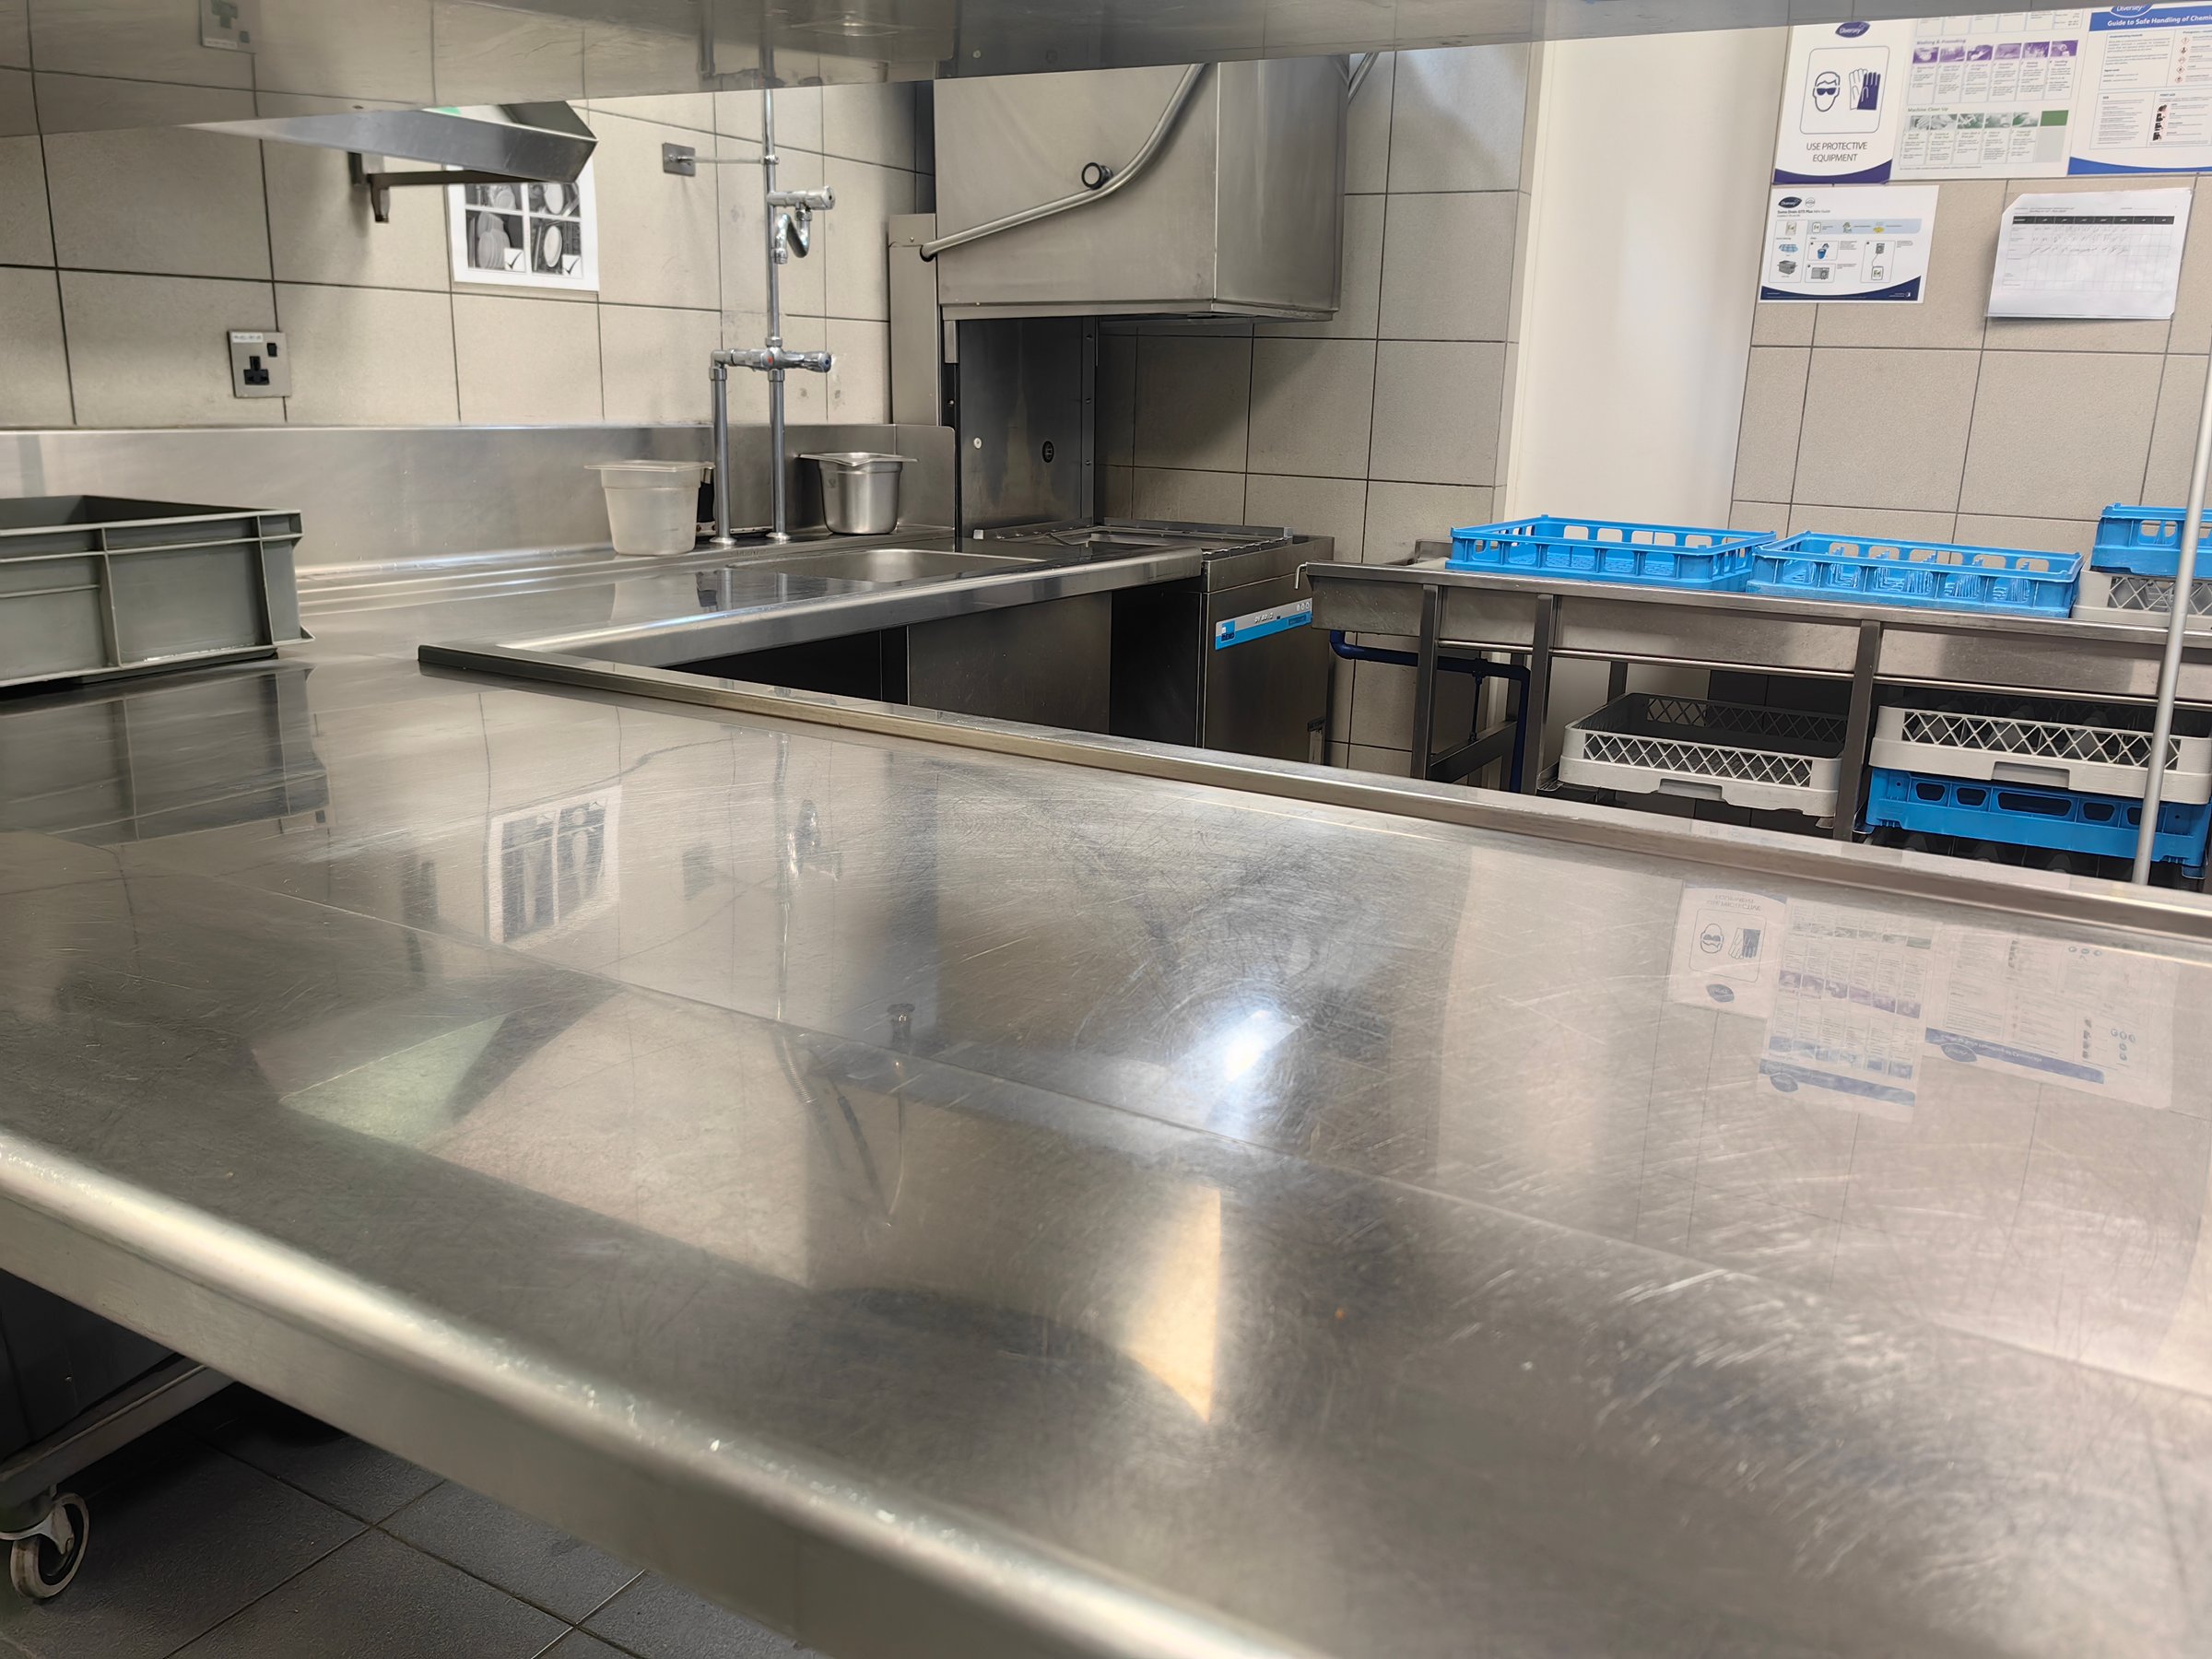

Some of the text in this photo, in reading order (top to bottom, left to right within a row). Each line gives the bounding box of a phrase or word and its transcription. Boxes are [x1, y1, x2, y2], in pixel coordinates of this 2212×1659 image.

[2151, 16, 2181, 24] Handling
[1806, 141, 1867, 151] USE PROTECTIVE
[1812, 153, 1858, 162] EQUIPMENT
